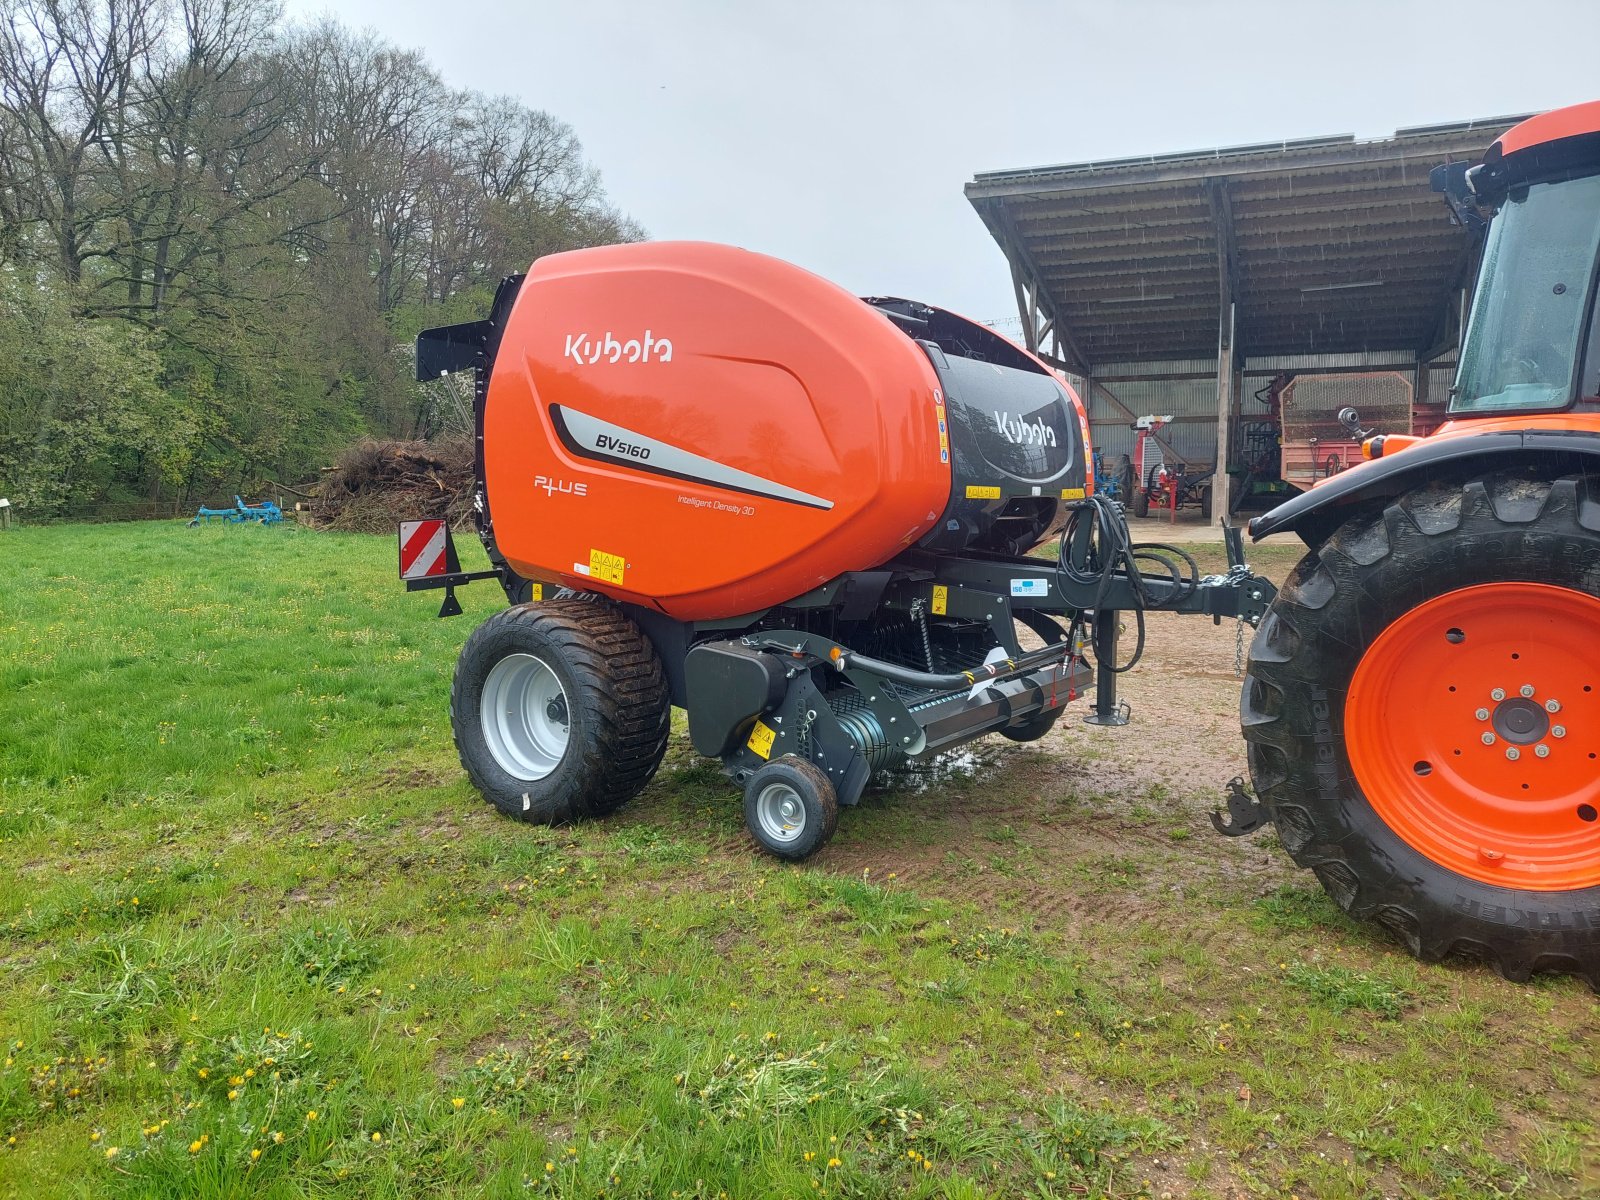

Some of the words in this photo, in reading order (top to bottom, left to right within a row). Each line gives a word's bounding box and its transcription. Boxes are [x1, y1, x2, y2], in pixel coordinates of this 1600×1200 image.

[564, 329, 673, 365] Kubota
[994, 410, 1057, 448] Kubota
[595, 433, 651, 460] BV5160
[534, 475, 588, 496] PLUS
[677, 494, 712, 508] Intelligent
[713, 500, 742, 516] Density
[741, 505, 755, 516] 3D
[1311, 685, 1340, 800] Kleber
